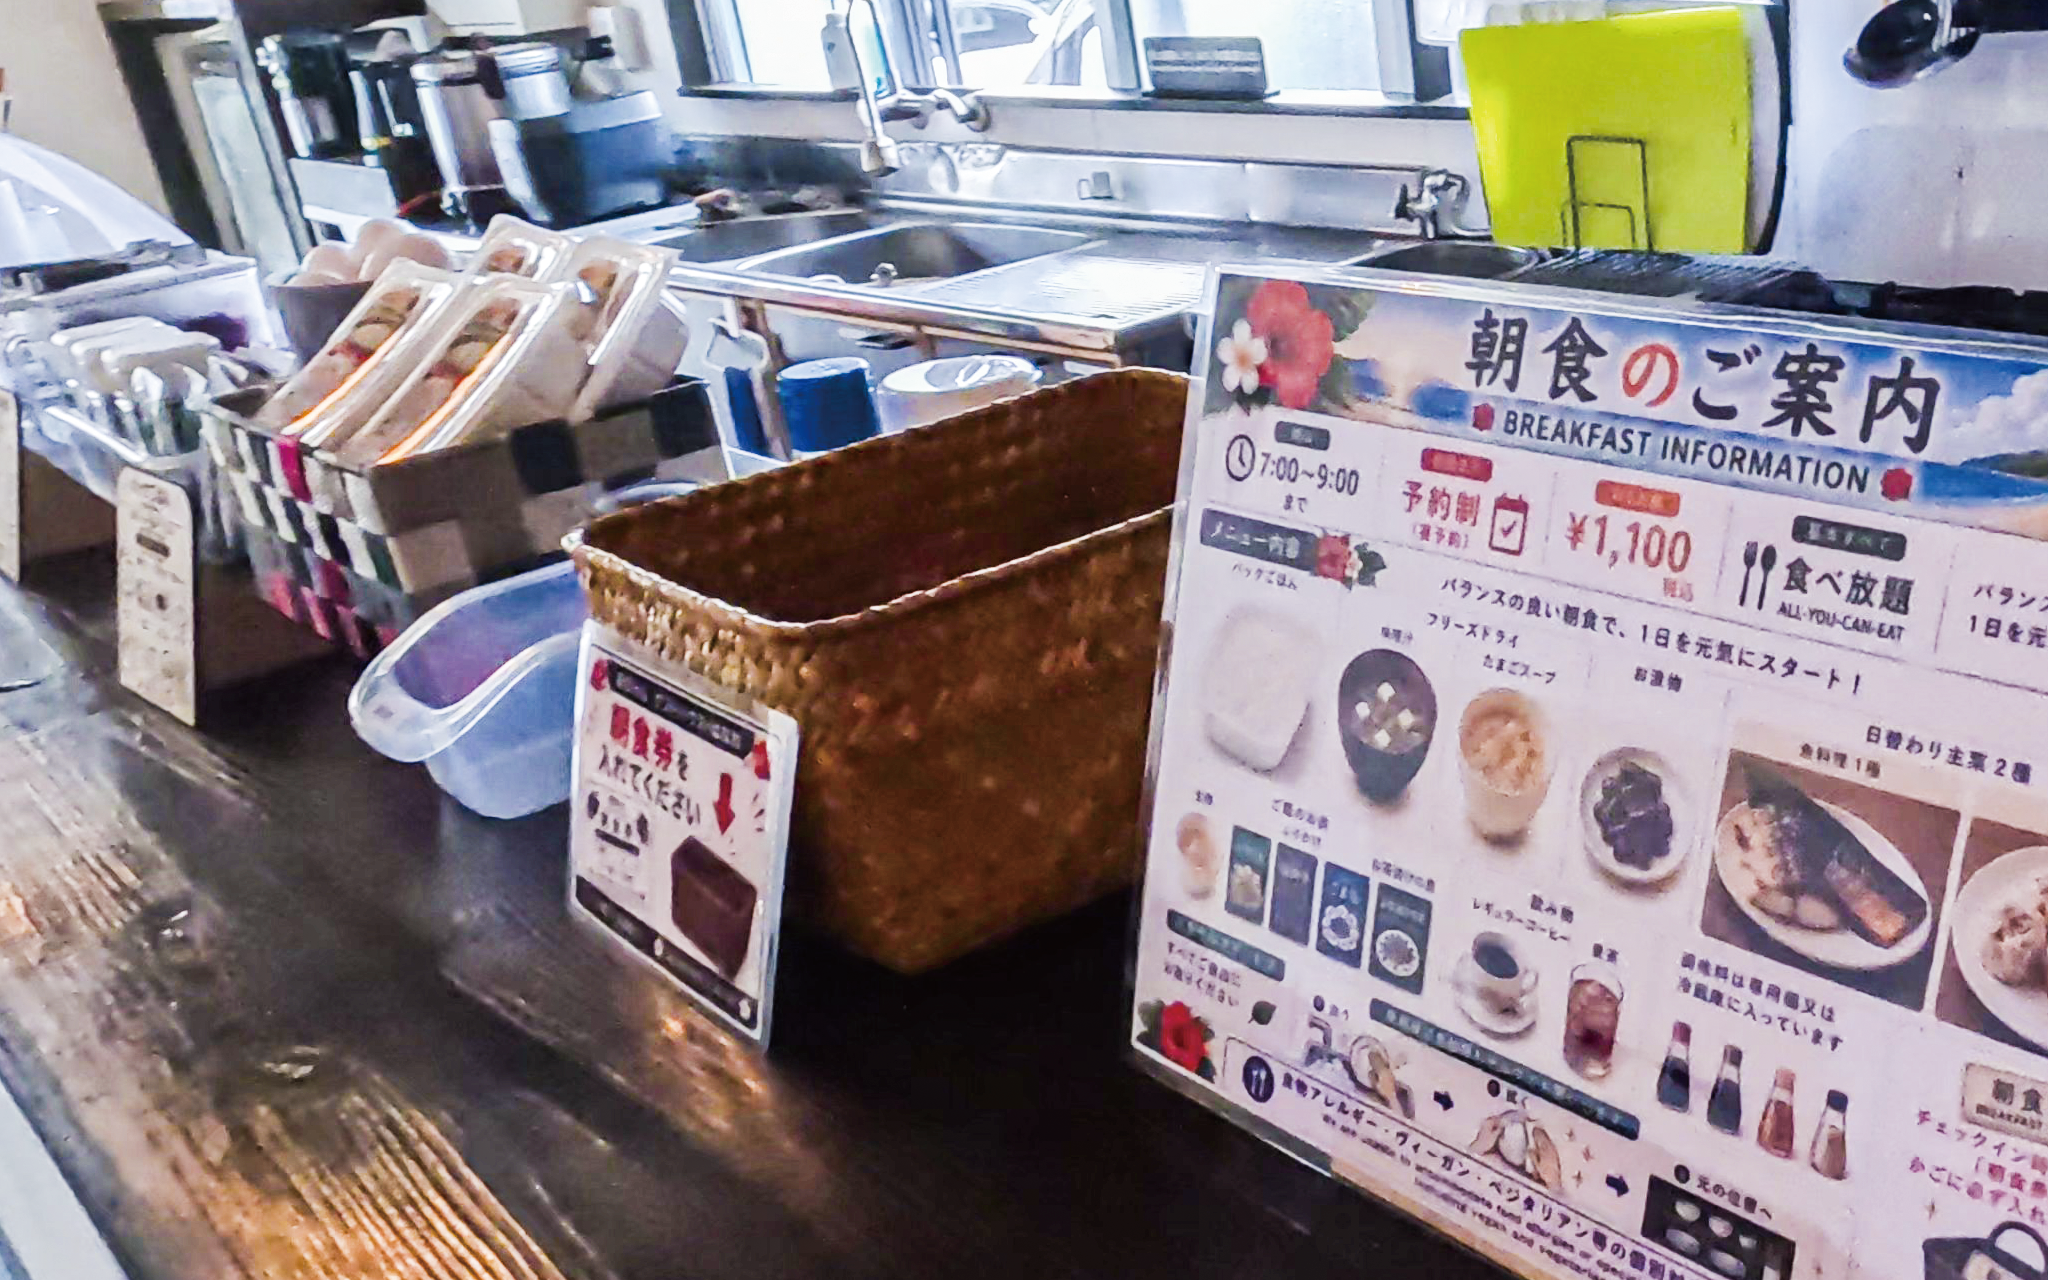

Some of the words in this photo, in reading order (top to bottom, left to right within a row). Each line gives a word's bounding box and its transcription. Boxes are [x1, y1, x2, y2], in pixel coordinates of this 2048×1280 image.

[1464, 308, 1941, 454] 朝食のご案内
[1503, 410, 1651, 457] BREAKFAST
[1661, 435, 1870, 494] INFORMATION
[1565, 511, 1691, 573] ¥1,100
[1783, 556, 1916, 615] 食べ放題
